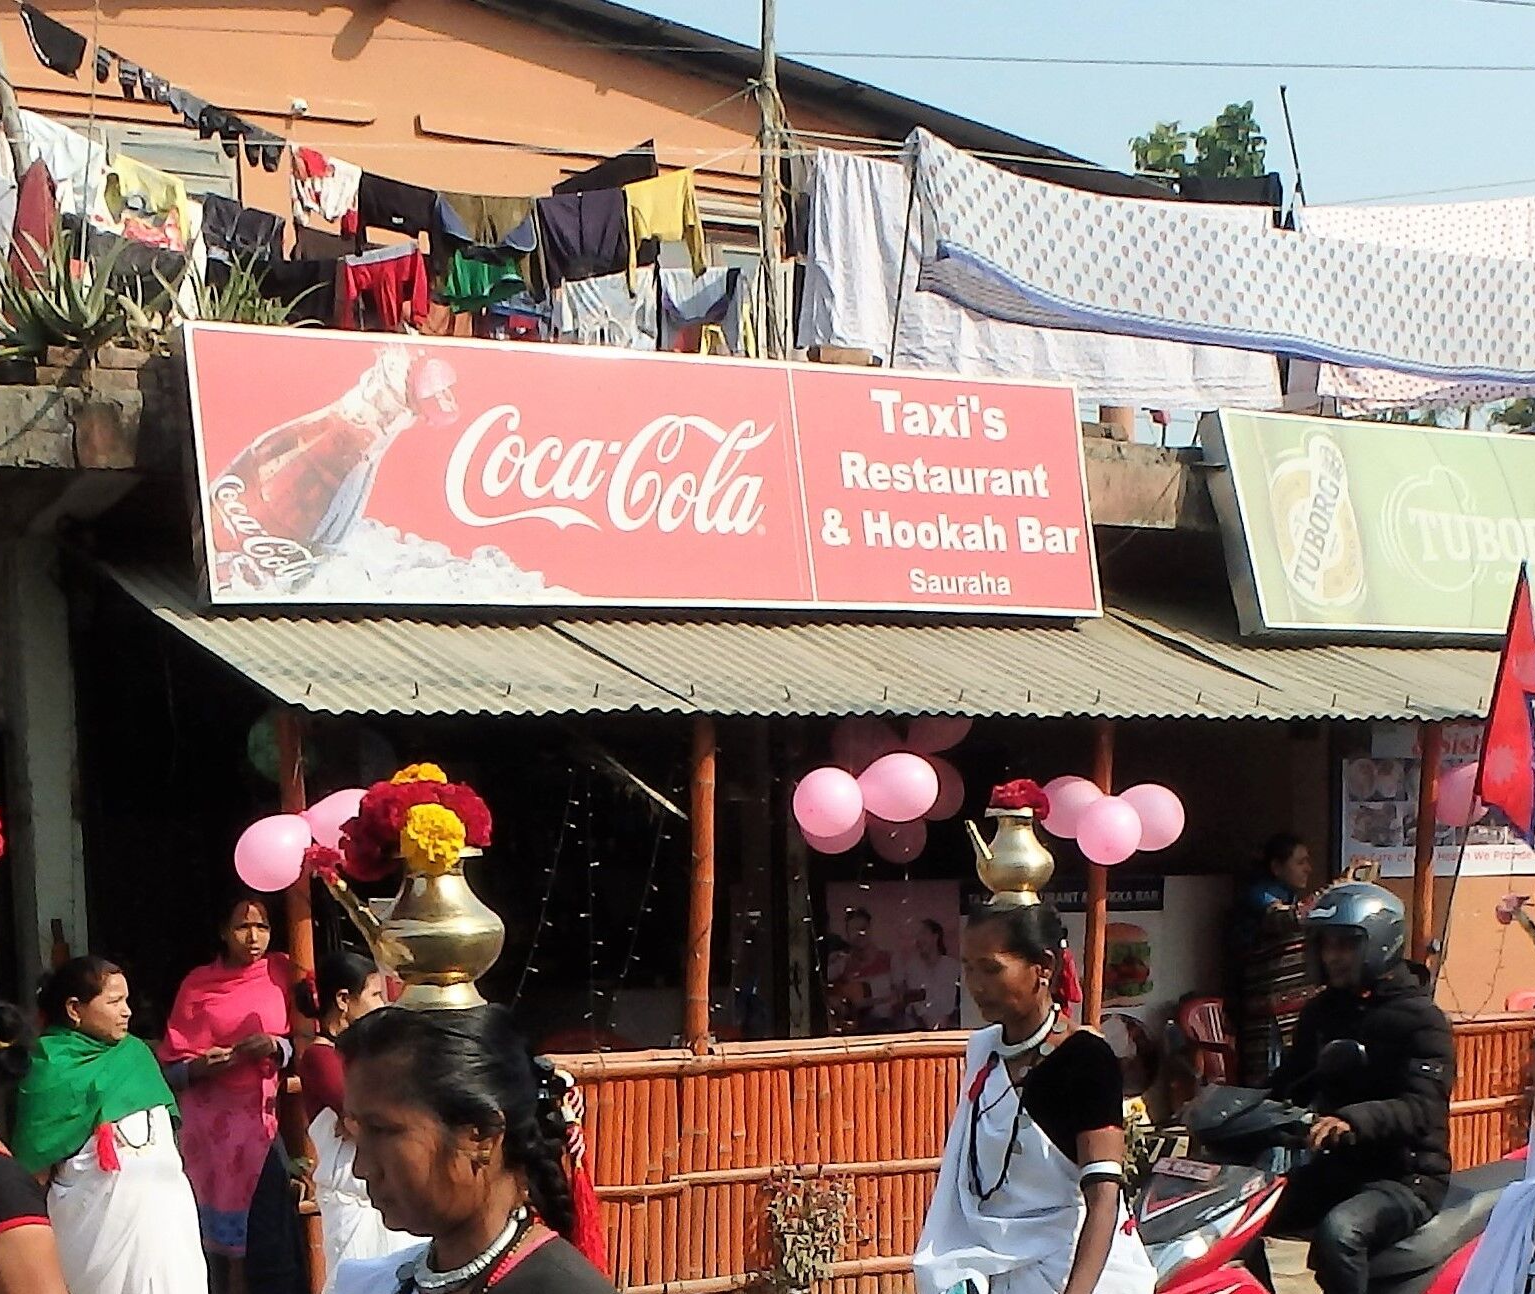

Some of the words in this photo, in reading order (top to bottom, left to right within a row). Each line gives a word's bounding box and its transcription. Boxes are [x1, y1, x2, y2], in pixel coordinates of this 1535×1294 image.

[869, 388, 1008, 441] Taxi's
[445, 404, 776, 535] Coca-Cola
[840, 450, 1050, 498] Restaurant
[821, 507, 851, 546] &
[862, 509, 1008, 552] Hookah
[1017, 516, 1081, 554] Bar
[1293, 474, 1341, 591] TUBORG
[909, 567, 1012, 596] Sauraha
